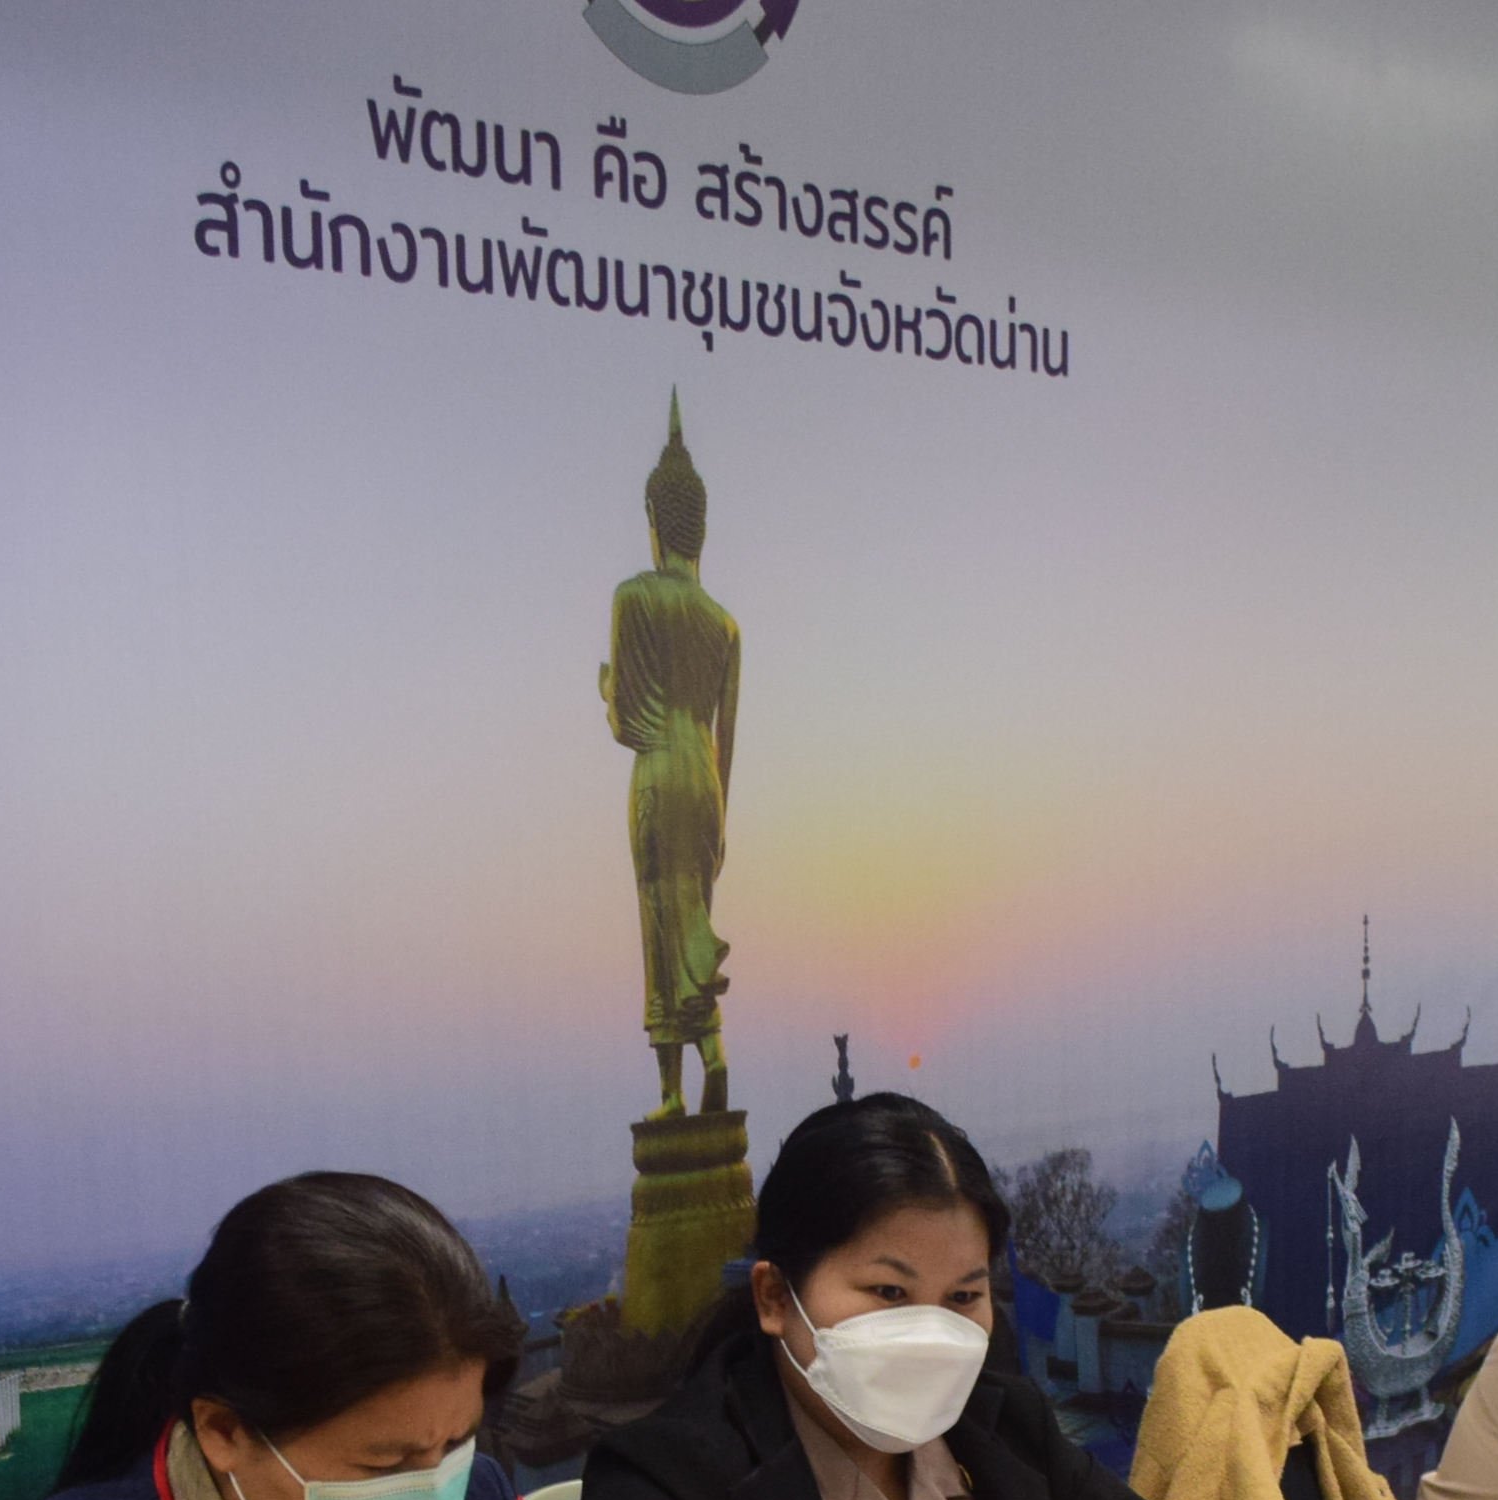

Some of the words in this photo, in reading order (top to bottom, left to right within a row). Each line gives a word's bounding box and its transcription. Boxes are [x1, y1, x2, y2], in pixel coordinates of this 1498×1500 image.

[366, 74, 561, 191] พัฒนา
[593, 115, 668, 210] คือ
[695, 142, 954, 260] สร้างสรรค์
[194, 160, 1068, 377] สำนักงานพัฒนาชุมชนจังหวัดน่าน
